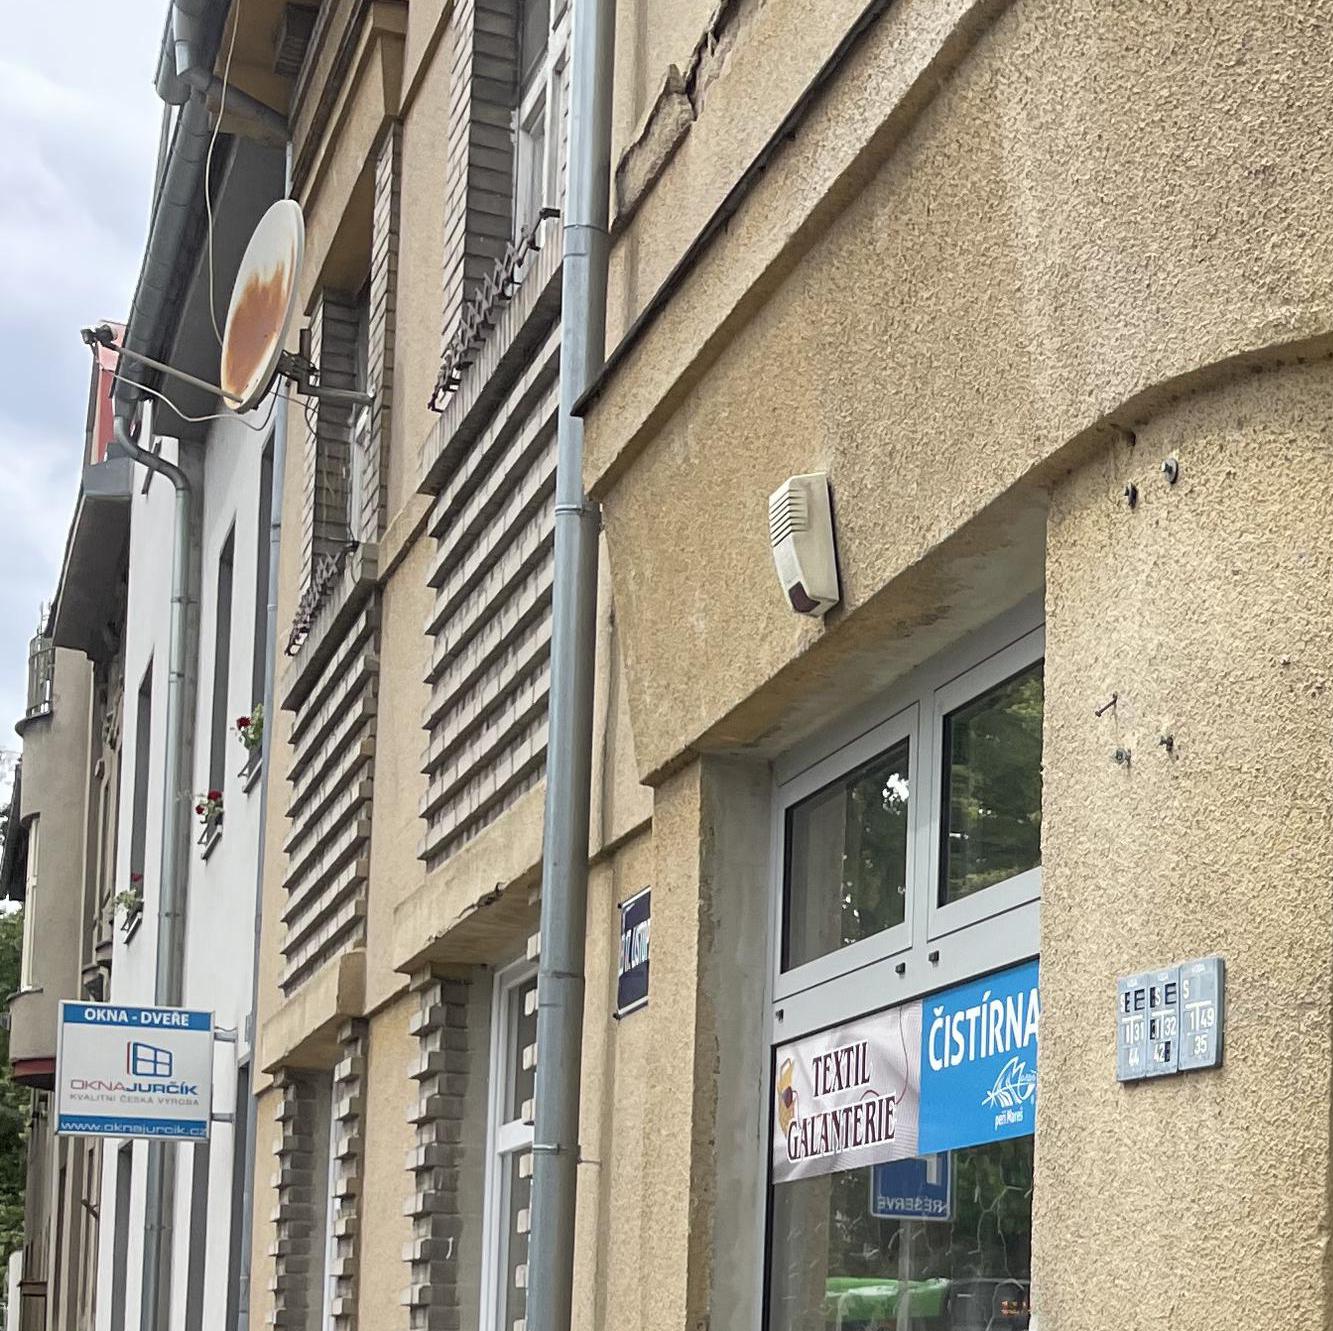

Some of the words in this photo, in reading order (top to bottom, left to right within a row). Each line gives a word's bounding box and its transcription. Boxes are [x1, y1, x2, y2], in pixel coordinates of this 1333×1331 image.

[84, 1008, 128, 1023] OKNA
[140, 1010, 189, 1026] DVEŘE
[929, 988, 1039, 1071] ČISTÍRNA
[812, 1041, 870, 1098] TEXTIL
[788, 1095, 896, 1161] GALANTERIE
